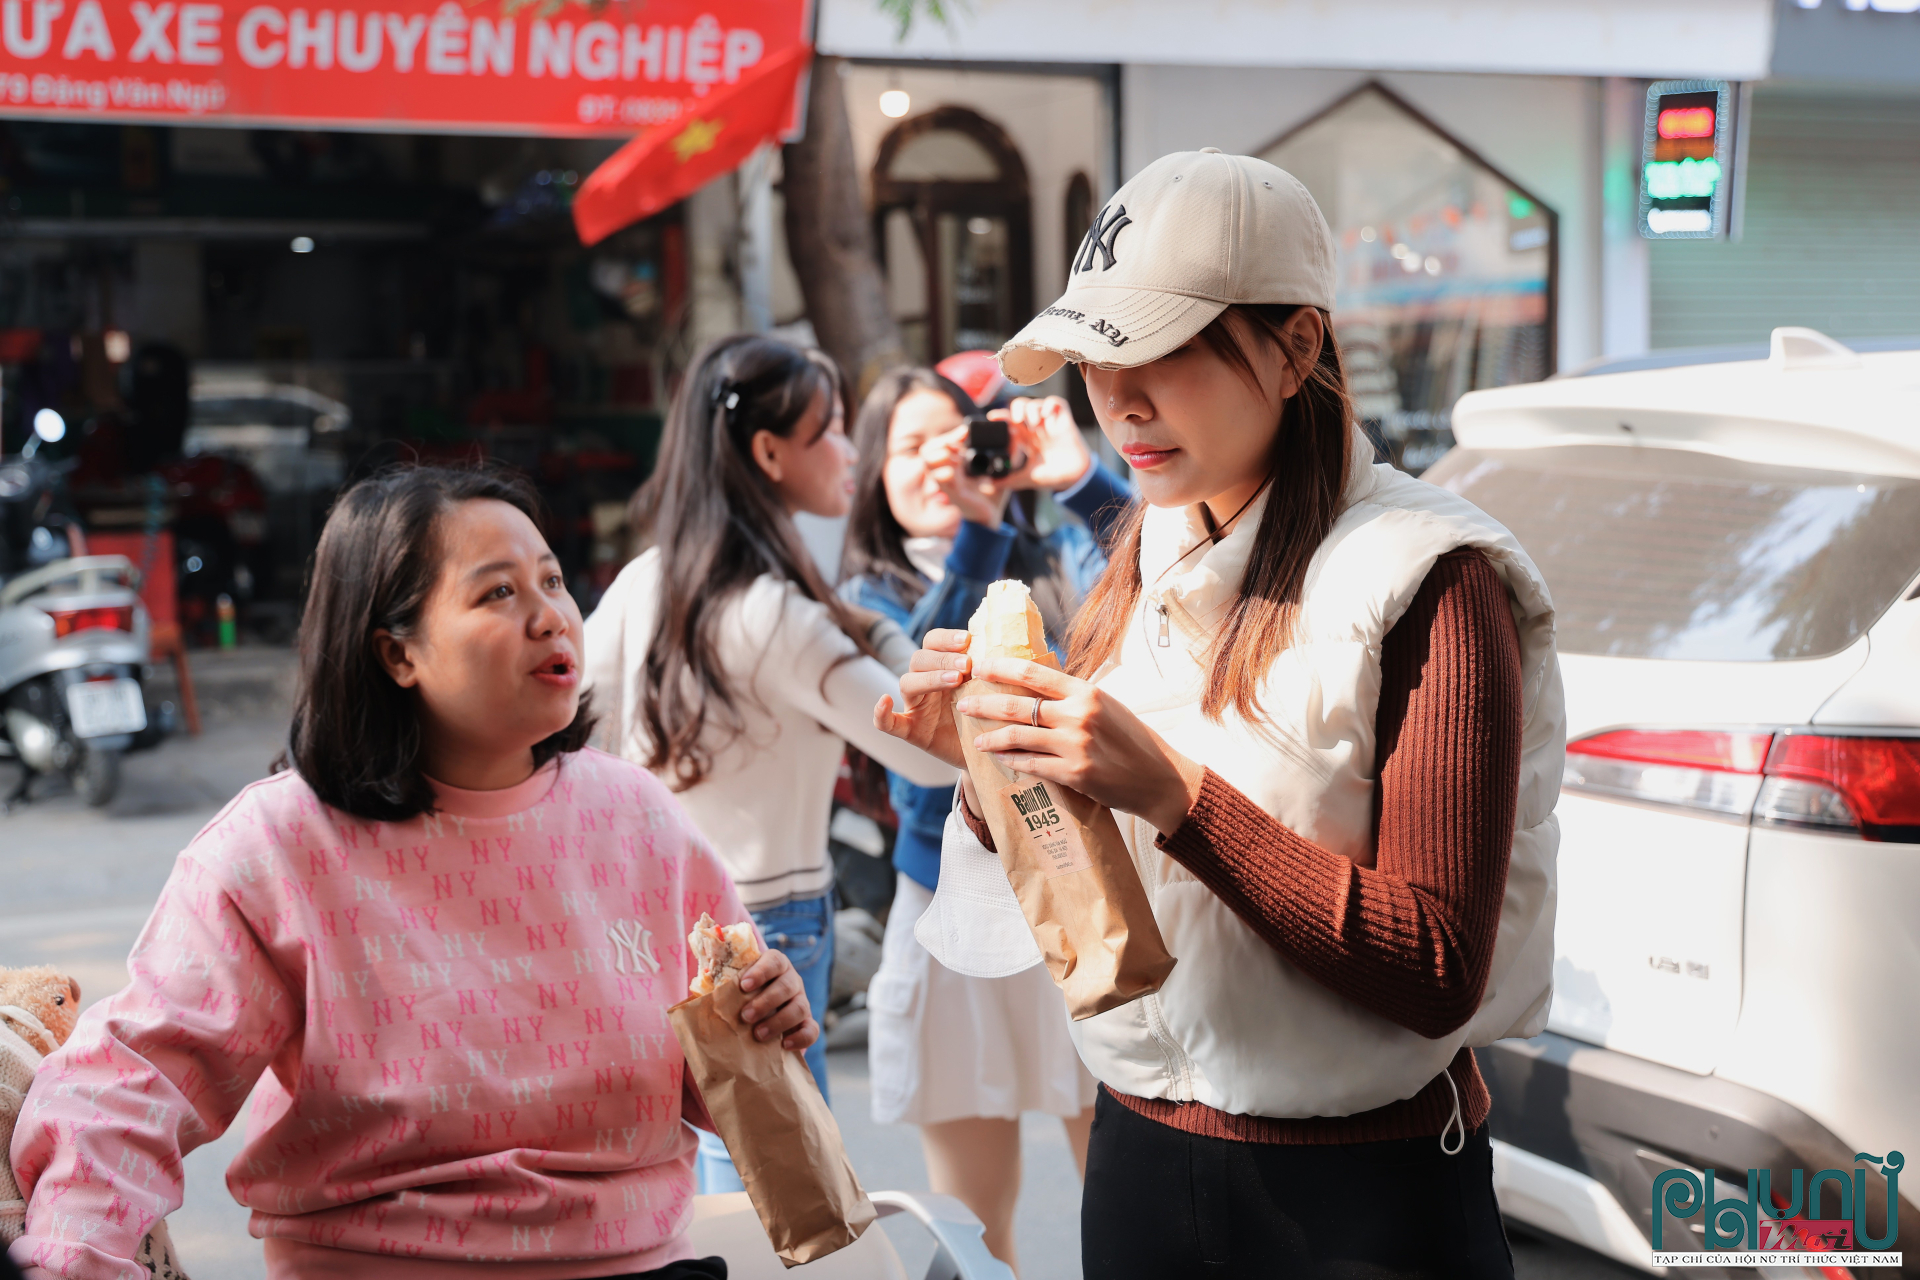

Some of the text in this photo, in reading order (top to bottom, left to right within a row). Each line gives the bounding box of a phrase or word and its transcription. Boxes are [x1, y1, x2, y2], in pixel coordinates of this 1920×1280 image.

[128, 1, 224, 66] XE
[236, 4, 516, 78] CHUYÊN
[527, 12, 764, 98] NGHIỆP
[1074, 204, 1132, 275] NY
[605, 784, 641, 805] NY
[262, 821, 304, 846] NY
[421, 813, 466, 839] NY
[506, 807, 545, 832] NY
[579, 808, 614, 831] NY
[1024, 808, 1060, 832] 1945
[340, 821, 381, 848] NY
[548, 835, 586, 859] NY
[621, 834, 655, 859] NY
[308, 846, 349, 875] NY
[385, 845, 429, 875] NY
[470, 837, 512, 865] NY
[231, 851, 276, 885] NY
[516, 864, 556, 890] NY
[590, 863, 627, 887] NY
[282, 877, 314, 906] NY
[354, 875, 391, 901] NY
[432, 871, 476, 900] NY
[480, 897, 522, 926] NY
[561, 891, 598, 915] NY
[631, 886, 669, 915] NY
[683, 891, 722, 918] NY
[251, 908, 292, 944] NY
[319, 906, 359, 936] NY
[398, 906, 439, 931] NY
[362, 934, 407, 964] NY
[442, 932, 486, 958] NY
[526, 921, 568, 951] NY
[606, 918, 660, 974] NY
[171, 948, 217, 980] NY
[410, 962, 451, 988] NY
[491, 956, 533, 983] NY
[572, 948, 611, 974] NY
[249, 972, 283, 1012] NY
[331, 970, 369, 998] NY
[537, 980, 579, 1010] NY
[616, 978, 653, 1001] NY
[199, 987, 247, 1021] NY
[372, 994, 416, 1027] NY
[457, 989, 498, 1015] NY
[502, 1015, 543, 1043] NY
[583, 1005, 625, 1034] NY
[220, 1029, 259, 1067] NY
[336, 1033, 378, 1059] NY
[419, 1021, 463, 1051] NY
[629, 1033, 666, 1060] NY
[466, 1049, 508, 1077] NY
[547, 1040, 590, 1070] NY
[300, 1064, 340, 1091] NY
[381, 1056, 426, 1087] NY
[594, 1065, 635, 1095] NY
[341, 1092, 386, 1113] NY
[428, 1082, 472, 1113] NY
[511, 1075, 554, 1104] NY
[556, 1100, 598, 1131] NY
[635, 1094, 674, 1122] NY
[41, 1118, 88, 1145] NY
[308, 1117, 352, 1134] NY
[388, 1115, 433, 1143] NY
[473, 1110, 517, 1140] NY
[345, 1135, 387, 1162] NY
[595, 1127, 638, 1153] NY
[70, 1152, 117, 1188] NY
[118, 1147, 156, 1189] NY
[464, 1153, 509, 1179] NY
[336, 1180, 376, 1204] NY
[519, 1177, 558, 1198] NY
[621, 1182, 650, 1212] NY
[103, 1194, 154, 1237] NY
[349, 1204, 388, 1232] NY
[472, 1193, 521, 1220] NY
[556, 1192, 596, 1220] NY
[652, 1203, 682, 1236] NY
[50, 1211, 101, 1242] NY
[309, 1221, 346, 1246] NY
[424, 1215, 472, 1247] NY
[512, 1225, 555, 1252] NY
[594, 1218, 627, 1250] NY
[31, 1242, 82, 1276] NY
